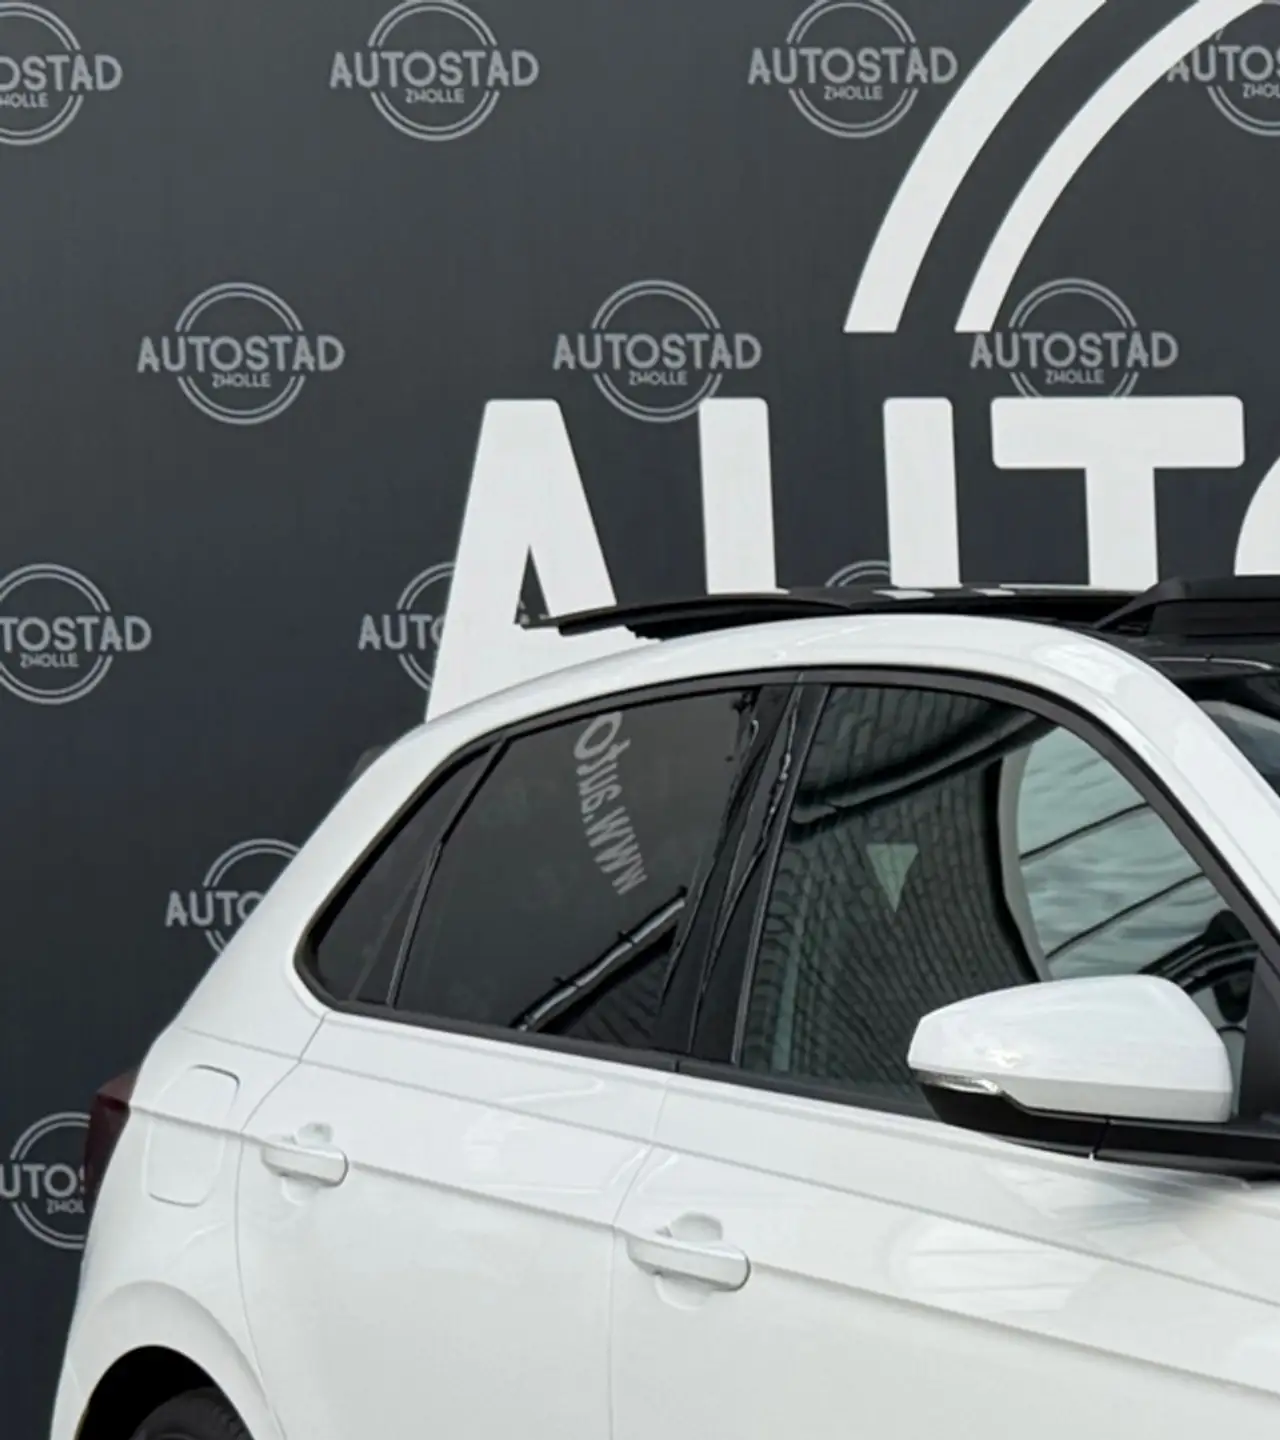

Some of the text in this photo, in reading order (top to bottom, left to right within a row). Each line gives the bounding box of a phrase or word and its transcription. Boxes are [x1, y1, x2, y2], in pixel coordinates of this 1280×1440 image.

[0, 54, 123, 91] OSTAD
[330, 52, 539, 88] AUTOSTAD
[748, 48, 958, 86] AUTOSTAD
[405, 88, 465, 104] ZWOLLE
[823, 86, 883, 101] ZWOLLE
[137, 335, 344, 373] AUTOSTAD
[553, 333, 761, 370] AUTOSTAD
[970, 332, 1178, 369] AUTOSTAD
[211, 373, 271, 388] ZWOLLE
[628, 370, 687, 386] ZWOLLE
[1045, 369, 1104, 385] ZWOLLE
[0, 615, 151, 652] TOSTAD
[19, 652, 80, 668] ZWOLLE
[165, 889, 264, 927] AUTO
